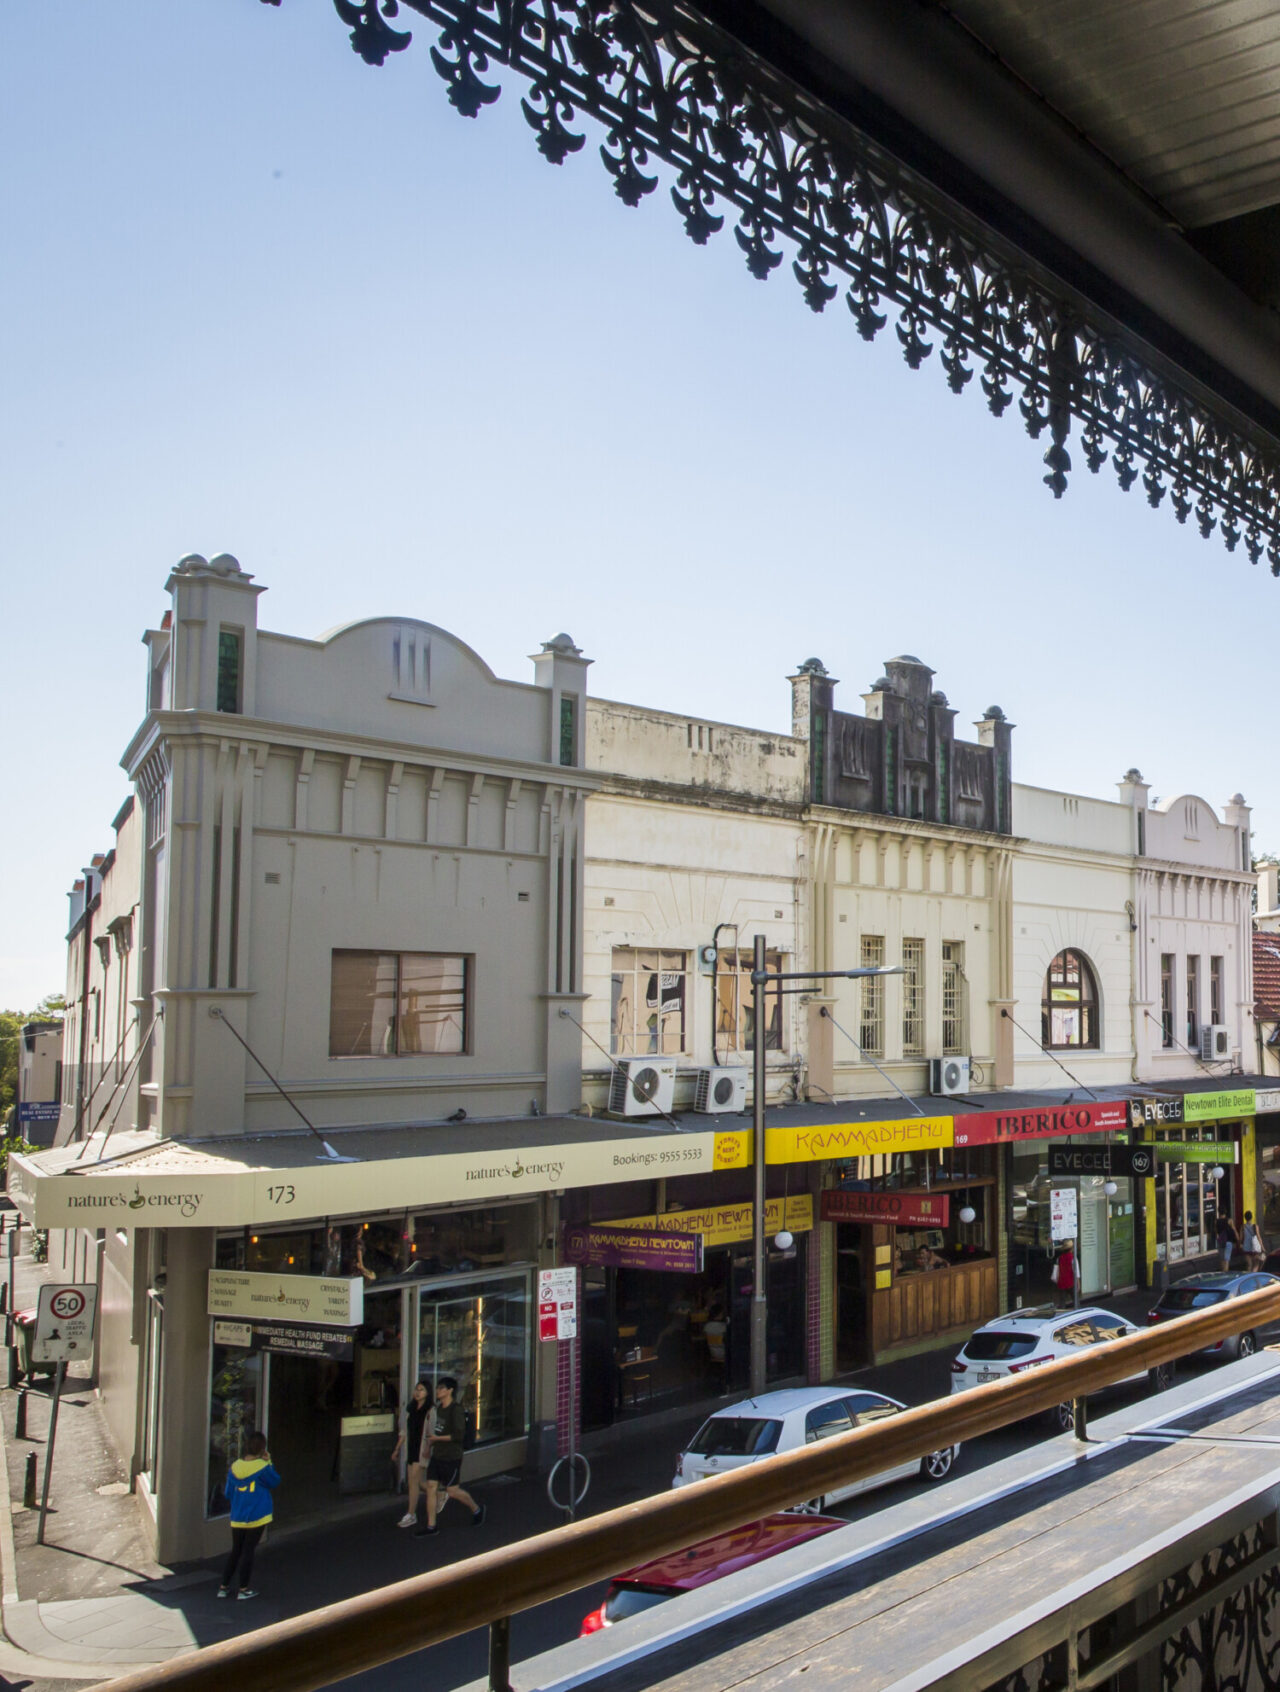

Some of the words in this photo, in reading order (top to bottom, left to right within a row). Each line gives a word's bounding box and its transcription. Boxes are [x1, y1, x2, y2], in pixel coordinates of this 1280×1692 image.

[1185, 1098, 1217, 1111] Newtown
[1218, 1095, 1232, 1108] Elite
[1233, 1093, 1253, 1107] Dental
[995, 1110, 1091, 1137] IBERICO
[796, 1123, 943, 1157] KAMMADHENU
[956, 1135, 968, 1145] 169
[613, 1151, 658, 1167] Bookings:
[660, 1150, 681, 1163] 9555
[682, 1148, 703, 1161] 5533
[1053, 1152, 1112, 1169] EYECEE
[1134, 1157, 1149, 1168] 167
[465, 1163, 511, 1181] nature's
[525, 1160, 566, 1182] energy
[266, 1185, 296, 1205] 173
[826, 1193, 902, 1214] IBERICO
[67, 1192, 127, 1208] nature's
[147, 1192, 204, 1218] energy
[717, 1202, 779, 1226] NEWTWN
[649, 1237, 694, 1251] NEWTOWN
[56, 1297, 79, 1312] 50
[285, 1296, 311, 1313] energy
[270, 1337, 296, 1348] REMEDIAL
[297, 1338, 324, 1351] MASSAGE
[285, 1327, 305, 1338] HEALTH
[306, 1329, 321, 1340] FUND
[322, 1330, 347, 1343] REBATES
